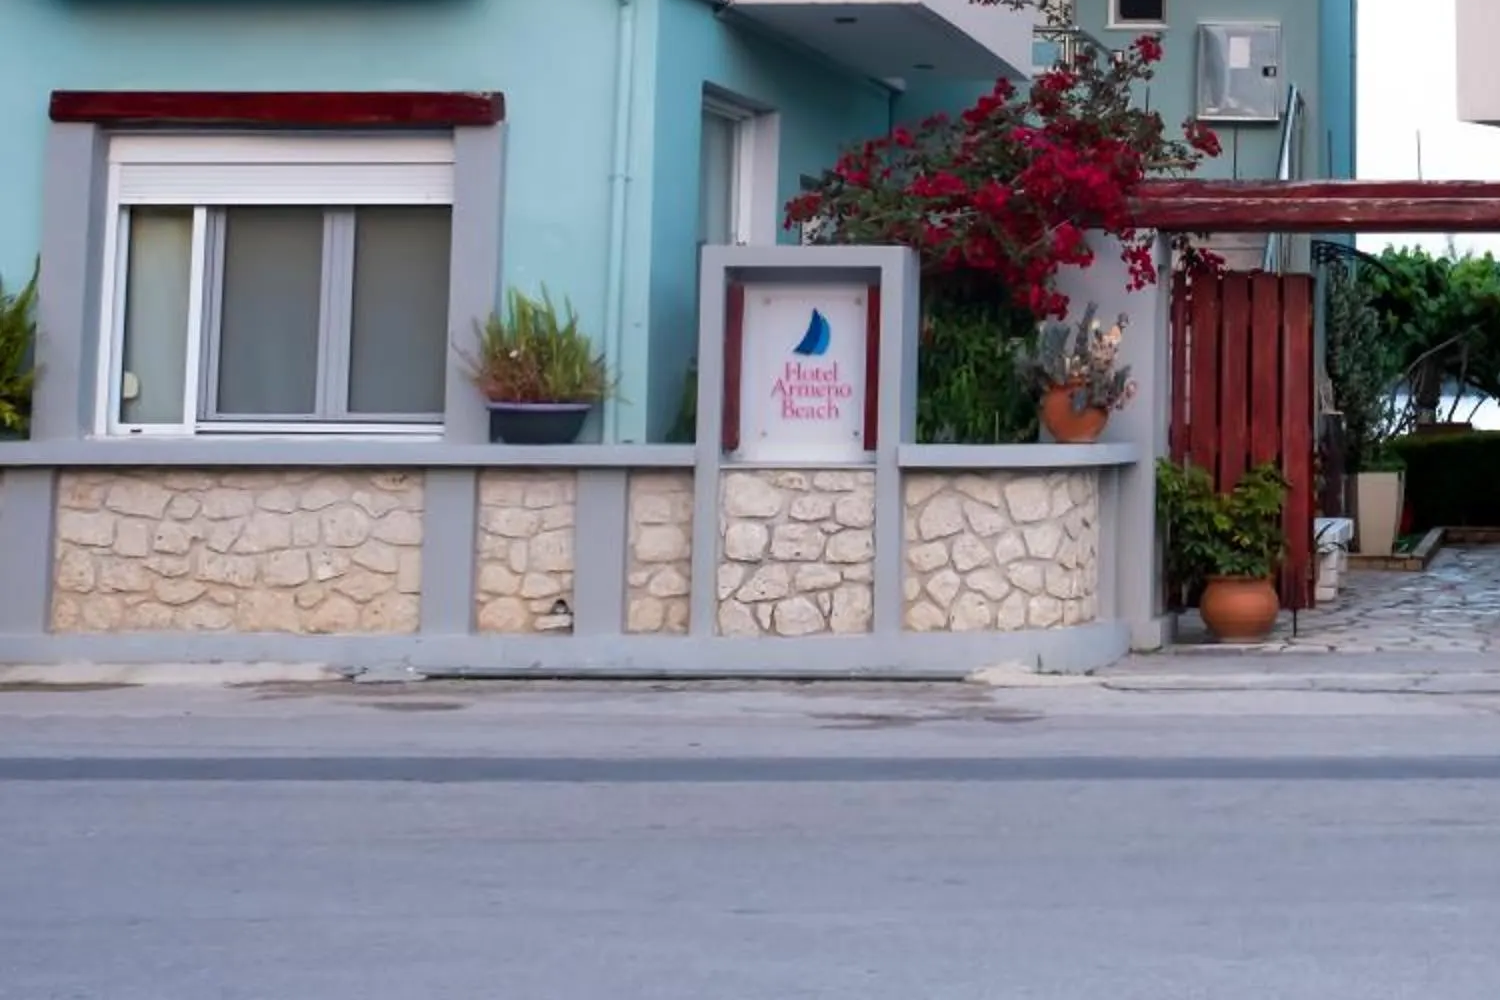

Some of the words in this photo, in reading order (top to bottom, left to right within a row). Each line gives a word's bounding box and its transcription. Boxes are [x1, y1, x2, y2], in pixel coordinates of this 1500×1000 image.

[785, 361, 838, 382] Hotel
[771, 378, 852, 398] Armeno
[782, 398, 840, 420] Beach
